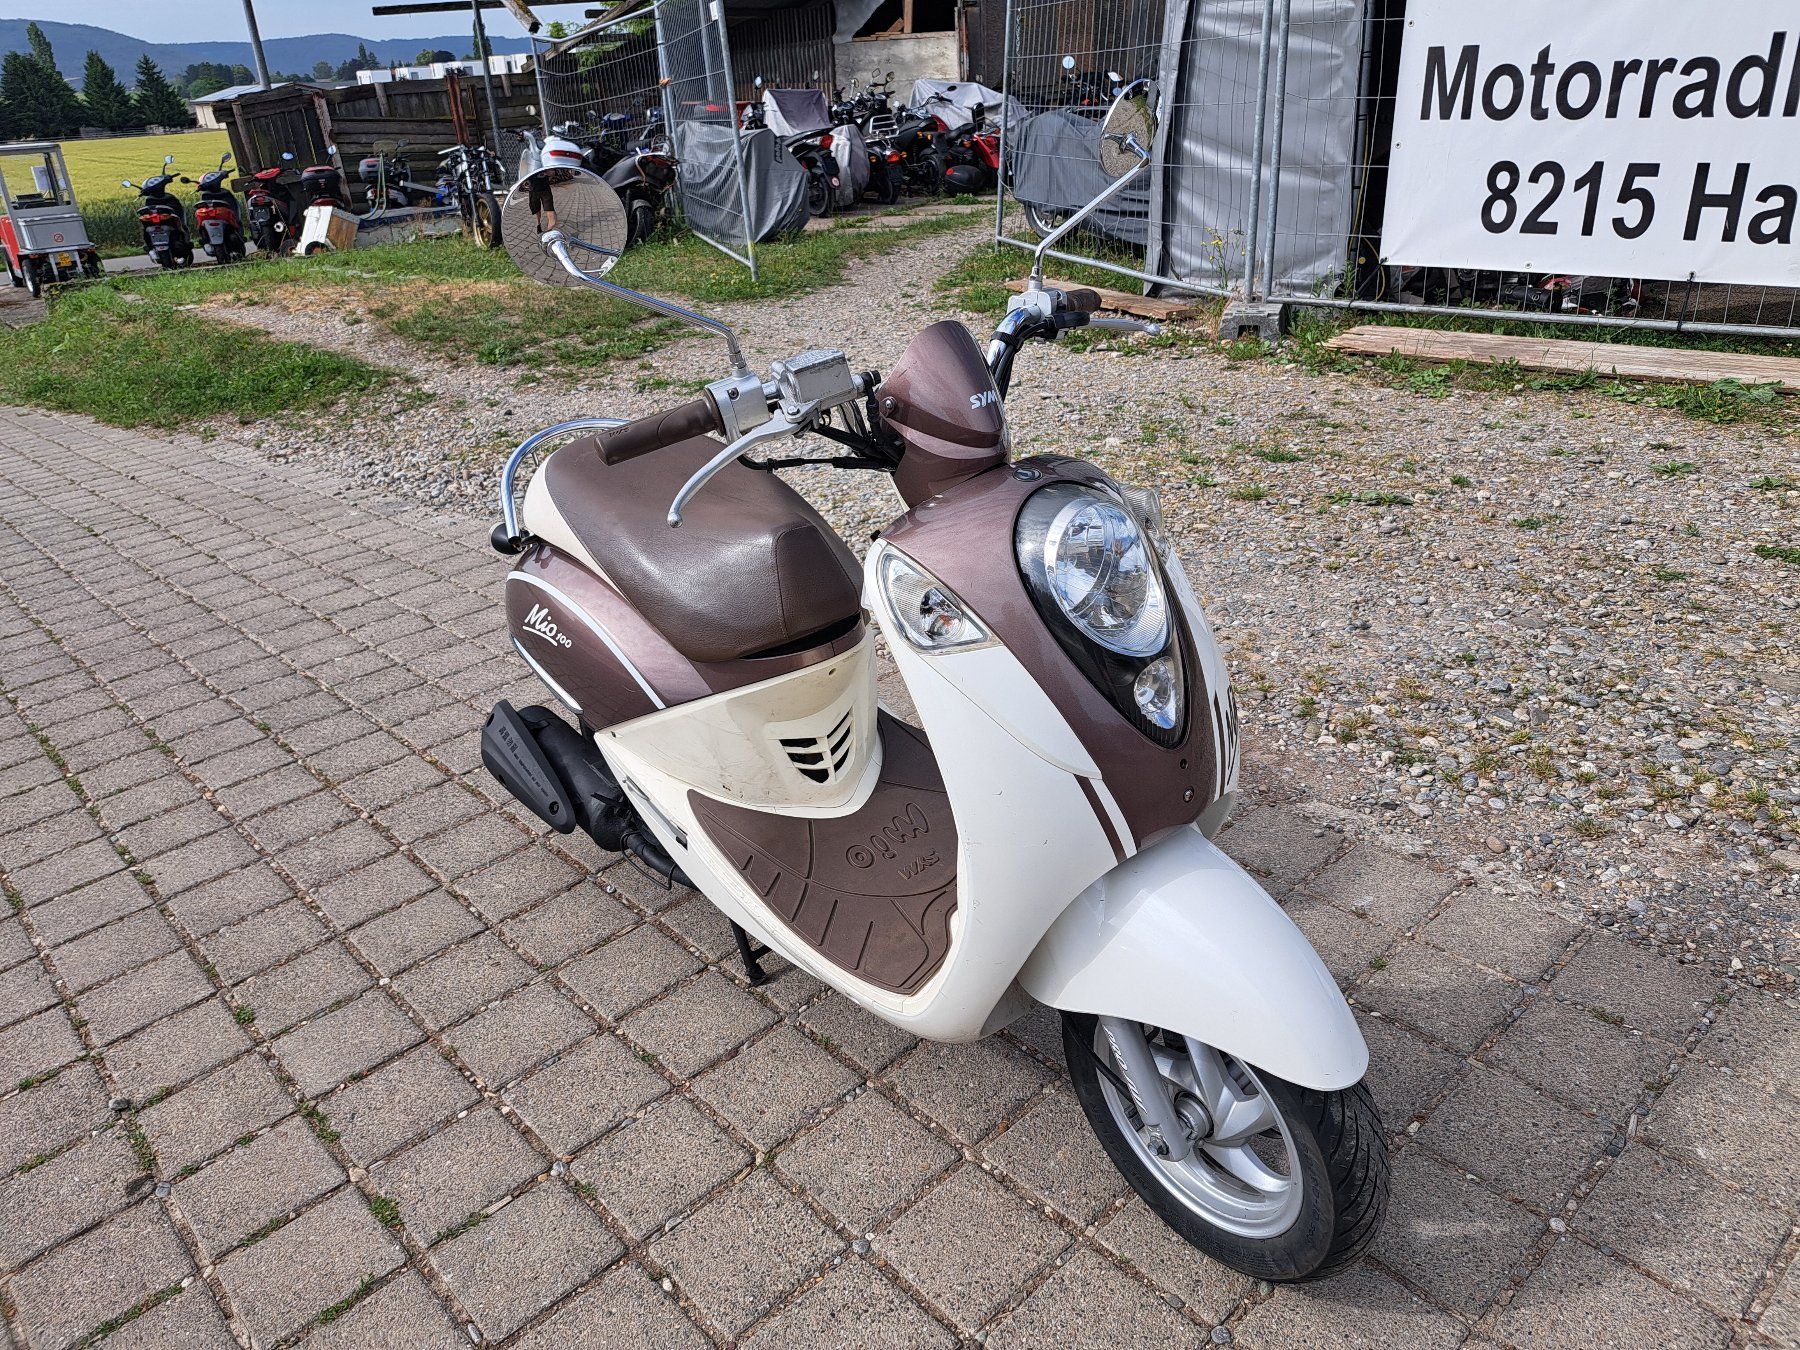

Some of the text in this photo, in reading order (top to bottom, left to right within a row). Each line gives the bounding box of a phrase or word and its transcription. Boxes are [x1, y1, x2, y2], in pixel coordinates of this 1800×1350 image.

[1481, 160, 1798, 245] 8215 Ha
[969, 389, 998, 410] SYM
[523, 603, 573, 649] Mio 100
